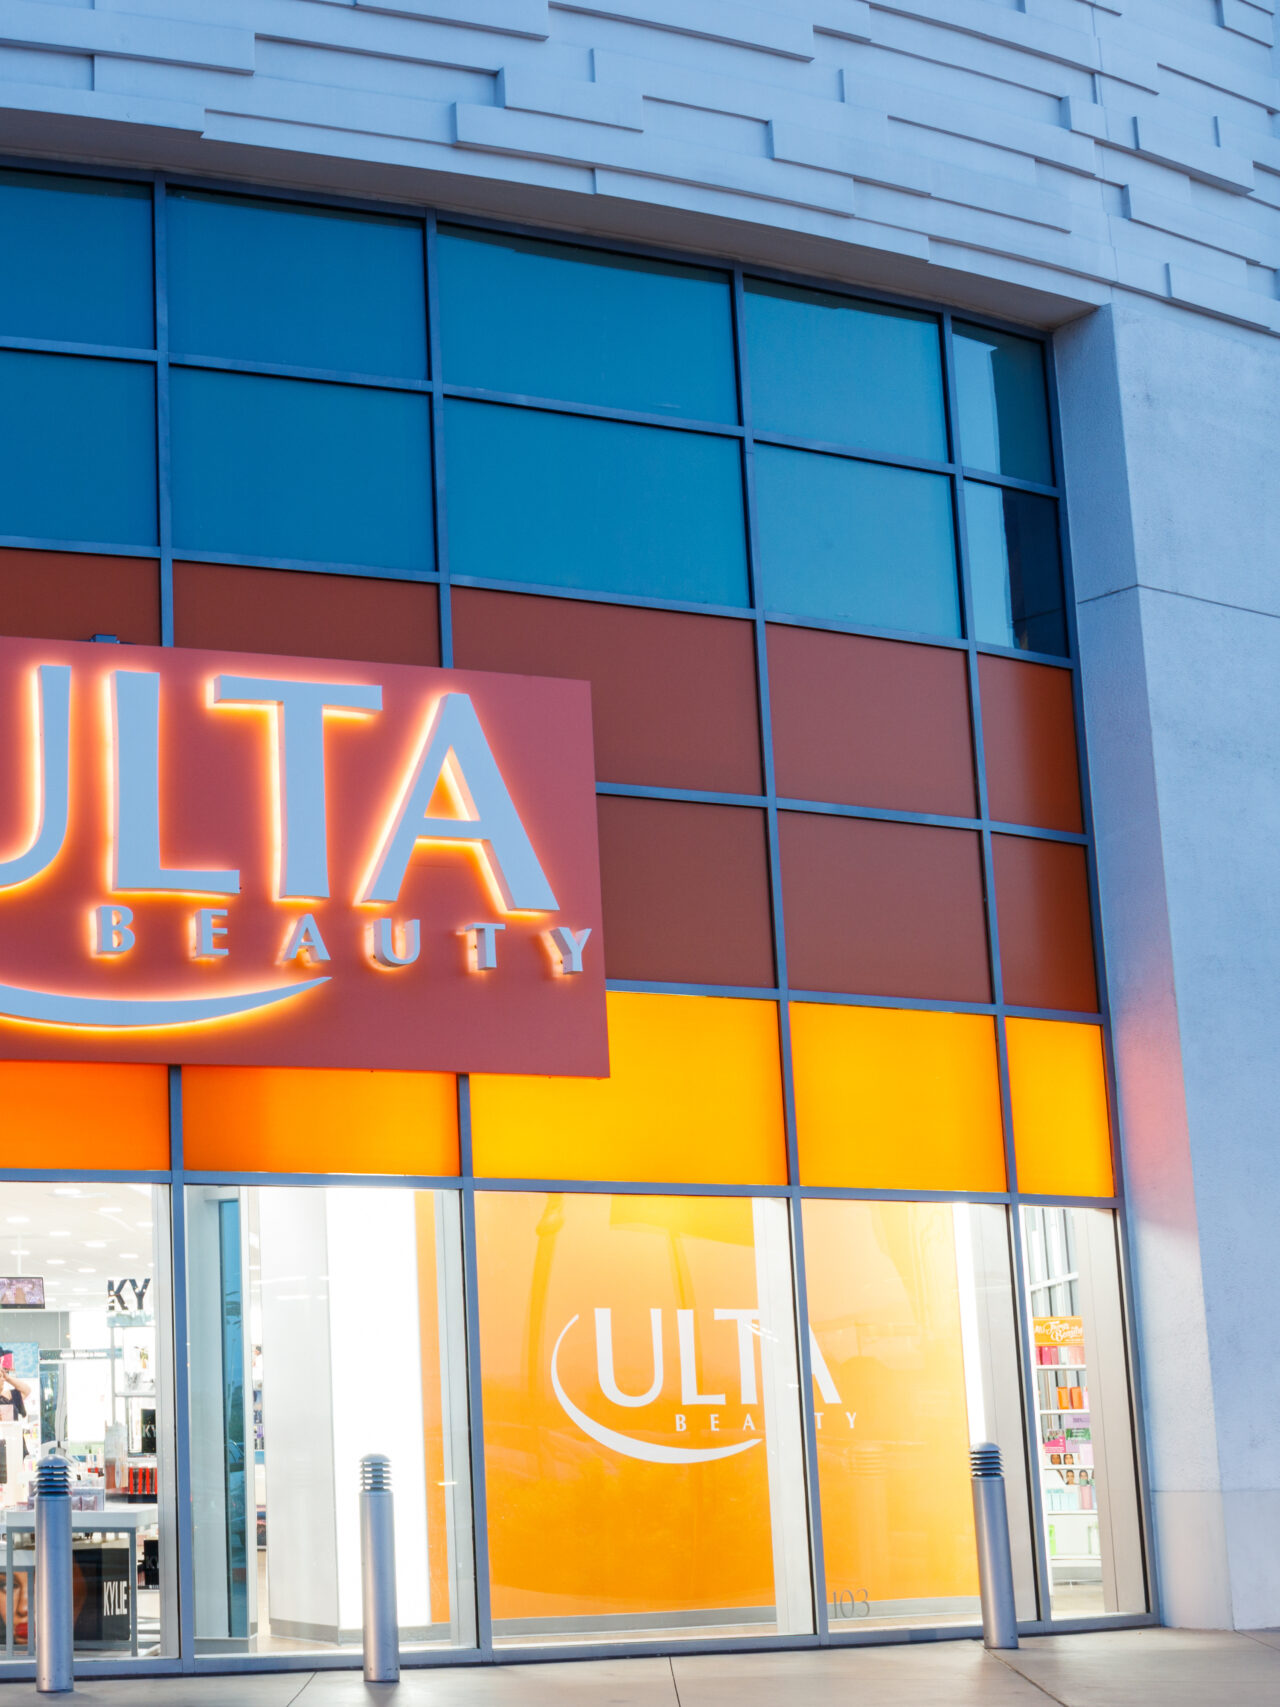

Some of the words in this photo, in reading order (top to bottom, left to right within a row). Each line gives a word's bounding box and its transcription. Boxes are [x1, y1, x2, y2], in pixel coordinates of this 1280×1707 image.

[95, 904, 592, 975] BEAUTY
[675, 1411, 857, 1432] BEATY
[103, 1581, 128, 1616] KYLIE
[832, 1588, 870, 1620] 103
